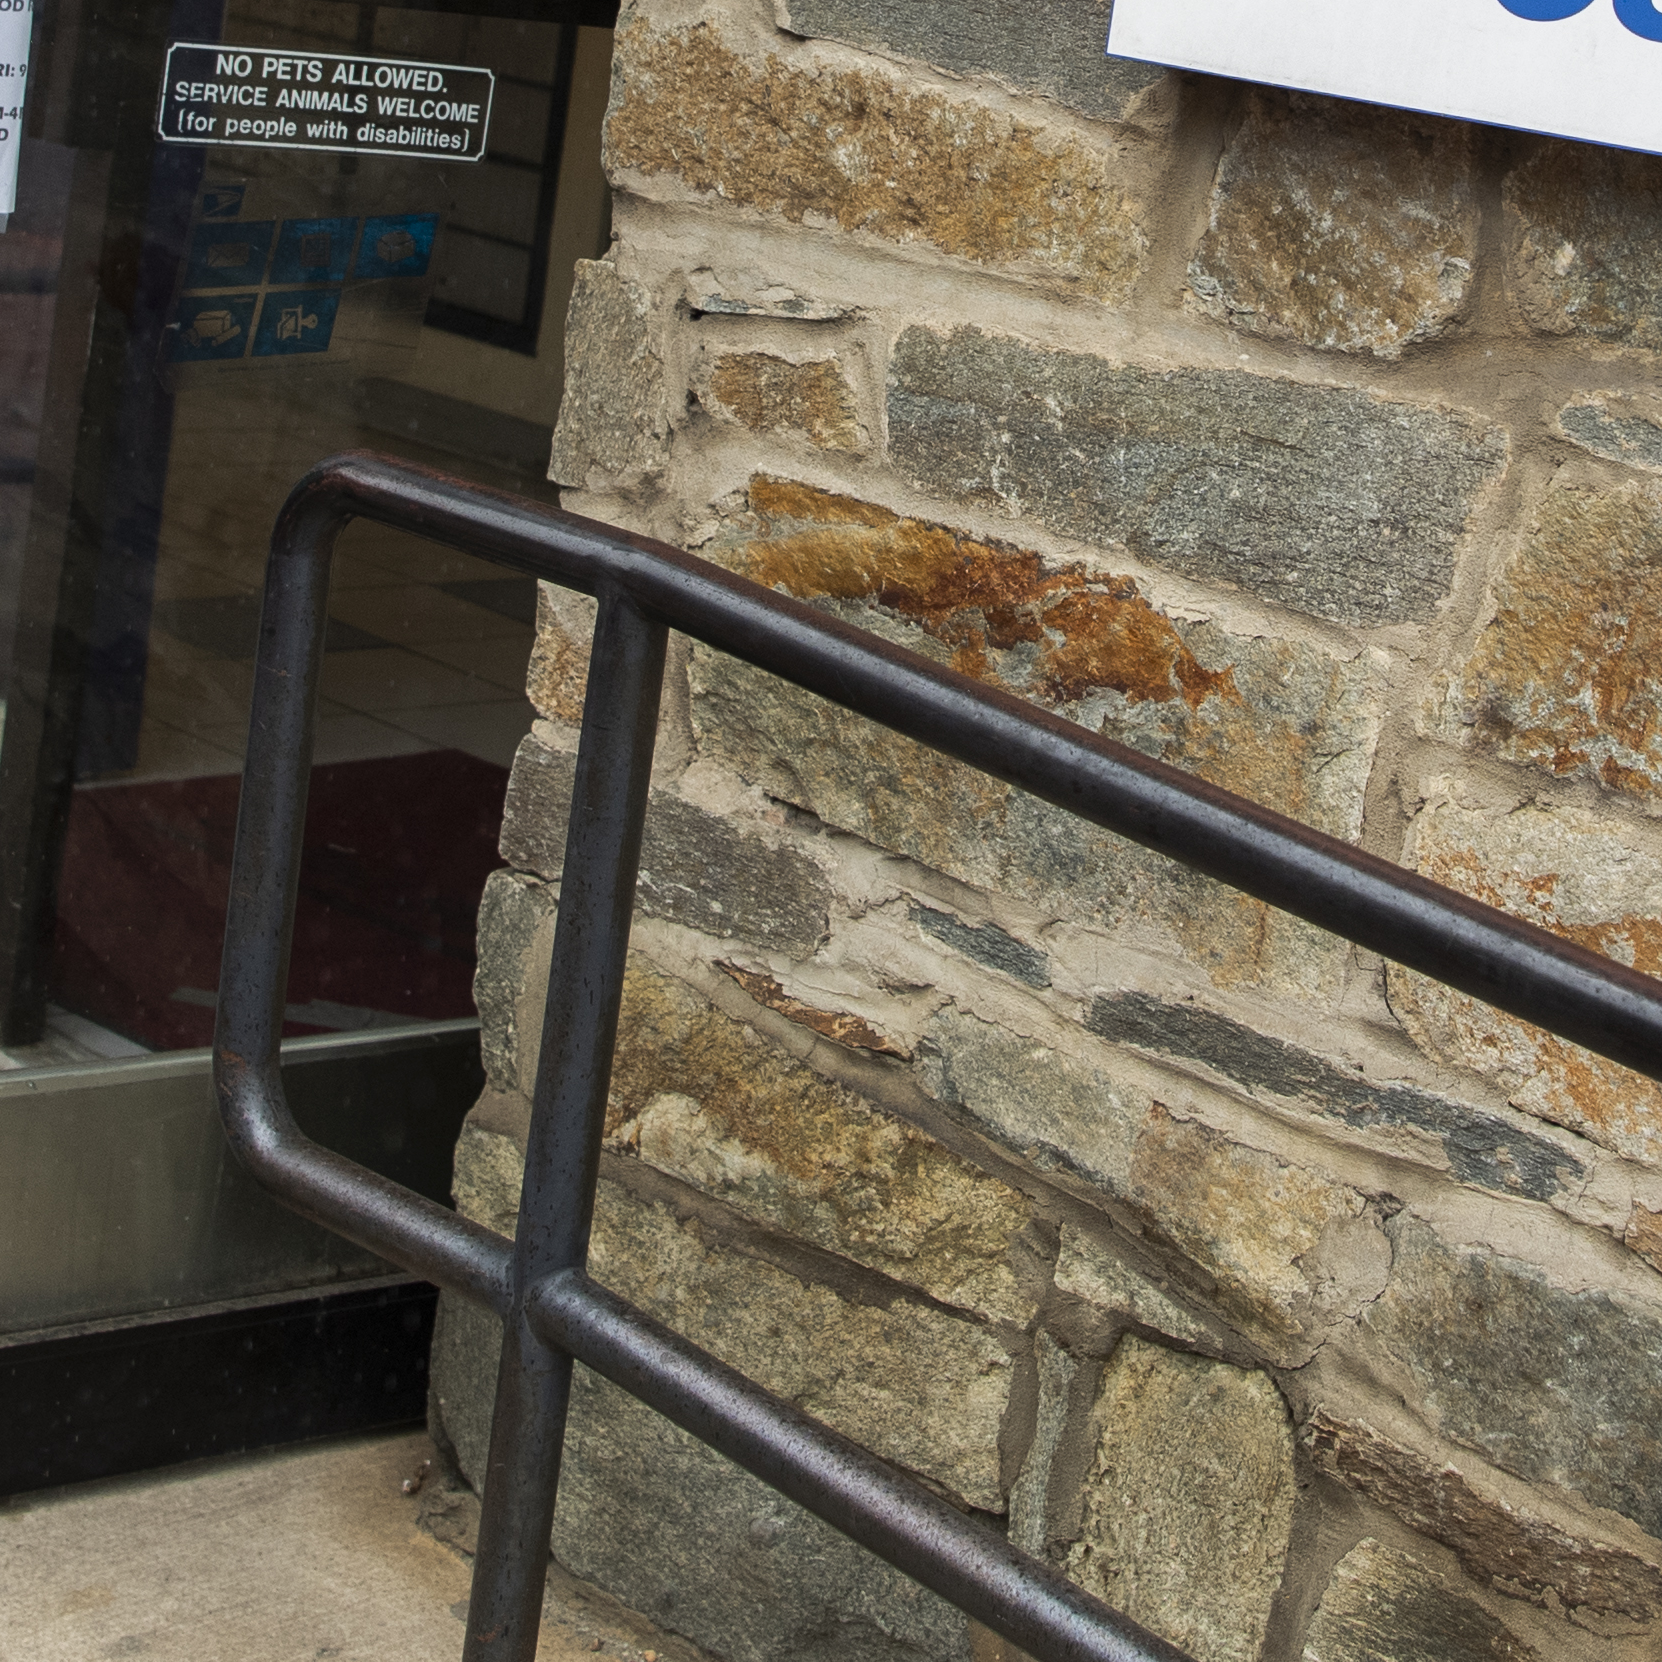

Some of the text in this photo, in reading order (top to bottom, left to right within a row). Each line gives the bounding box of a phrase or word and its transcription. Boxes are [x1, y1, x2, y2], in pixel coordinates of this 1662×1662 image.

[216, 54, 448, 93] NO PETS ALLOWED.
[174, 81, 480, 123] SERVICE ANIMALS WELCOME
[225, 116, 297, 138] people
[307, 121, 348, 139] with
